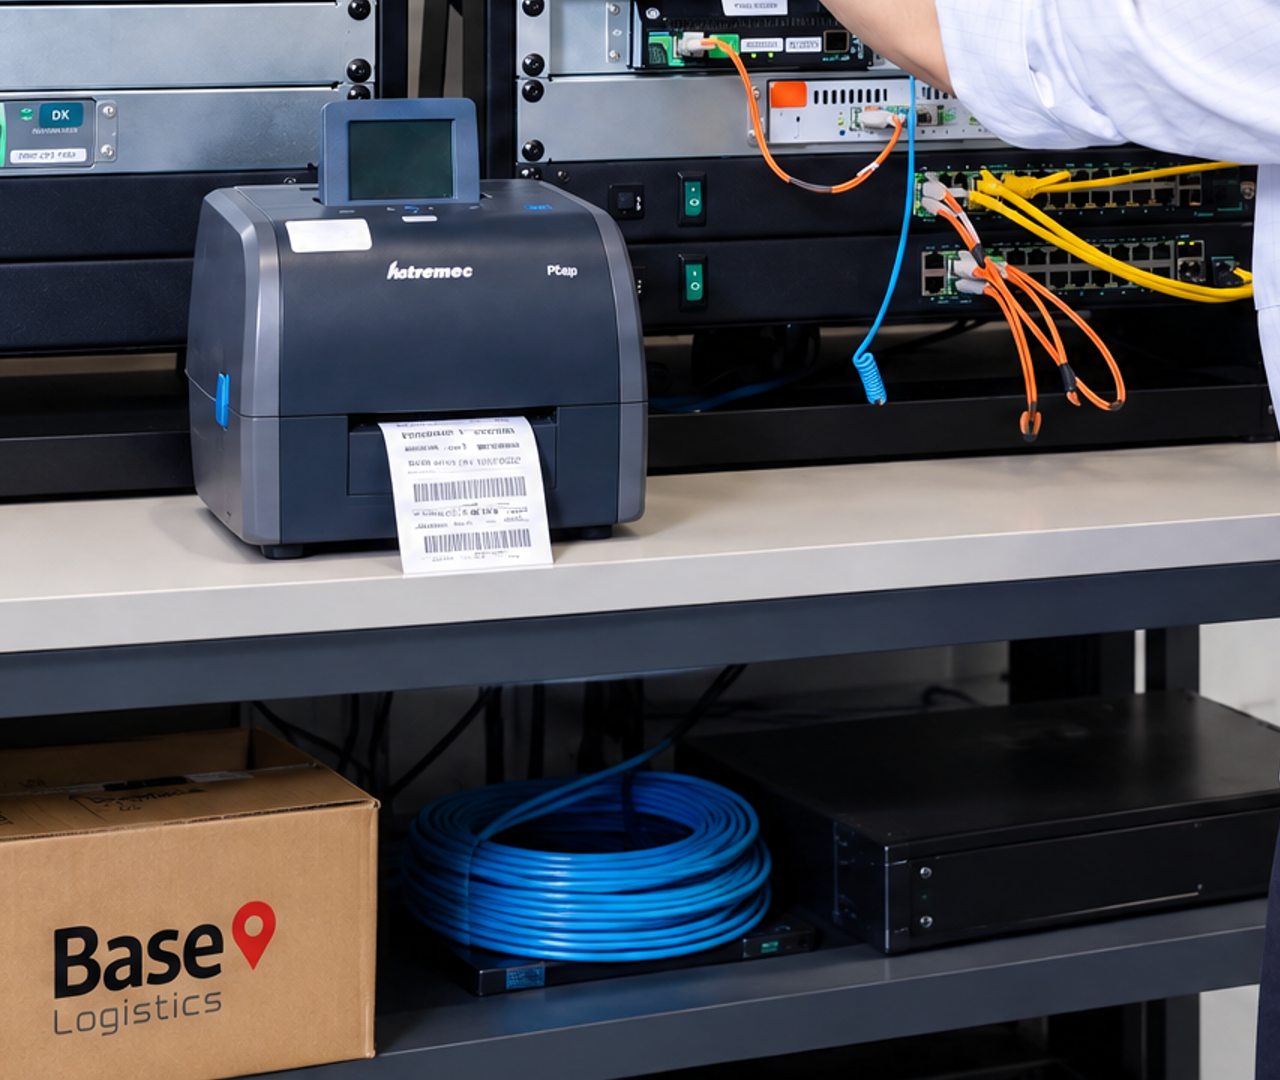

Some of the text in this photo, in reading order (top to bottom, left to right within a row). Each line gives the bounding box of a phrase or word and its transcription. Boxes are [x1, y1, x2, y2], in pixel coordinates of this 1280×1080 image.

[52, 110, 69, 120] DX
[53, 923, 224, 1003] Base
[53, 986, 222, 1037] Logistics
